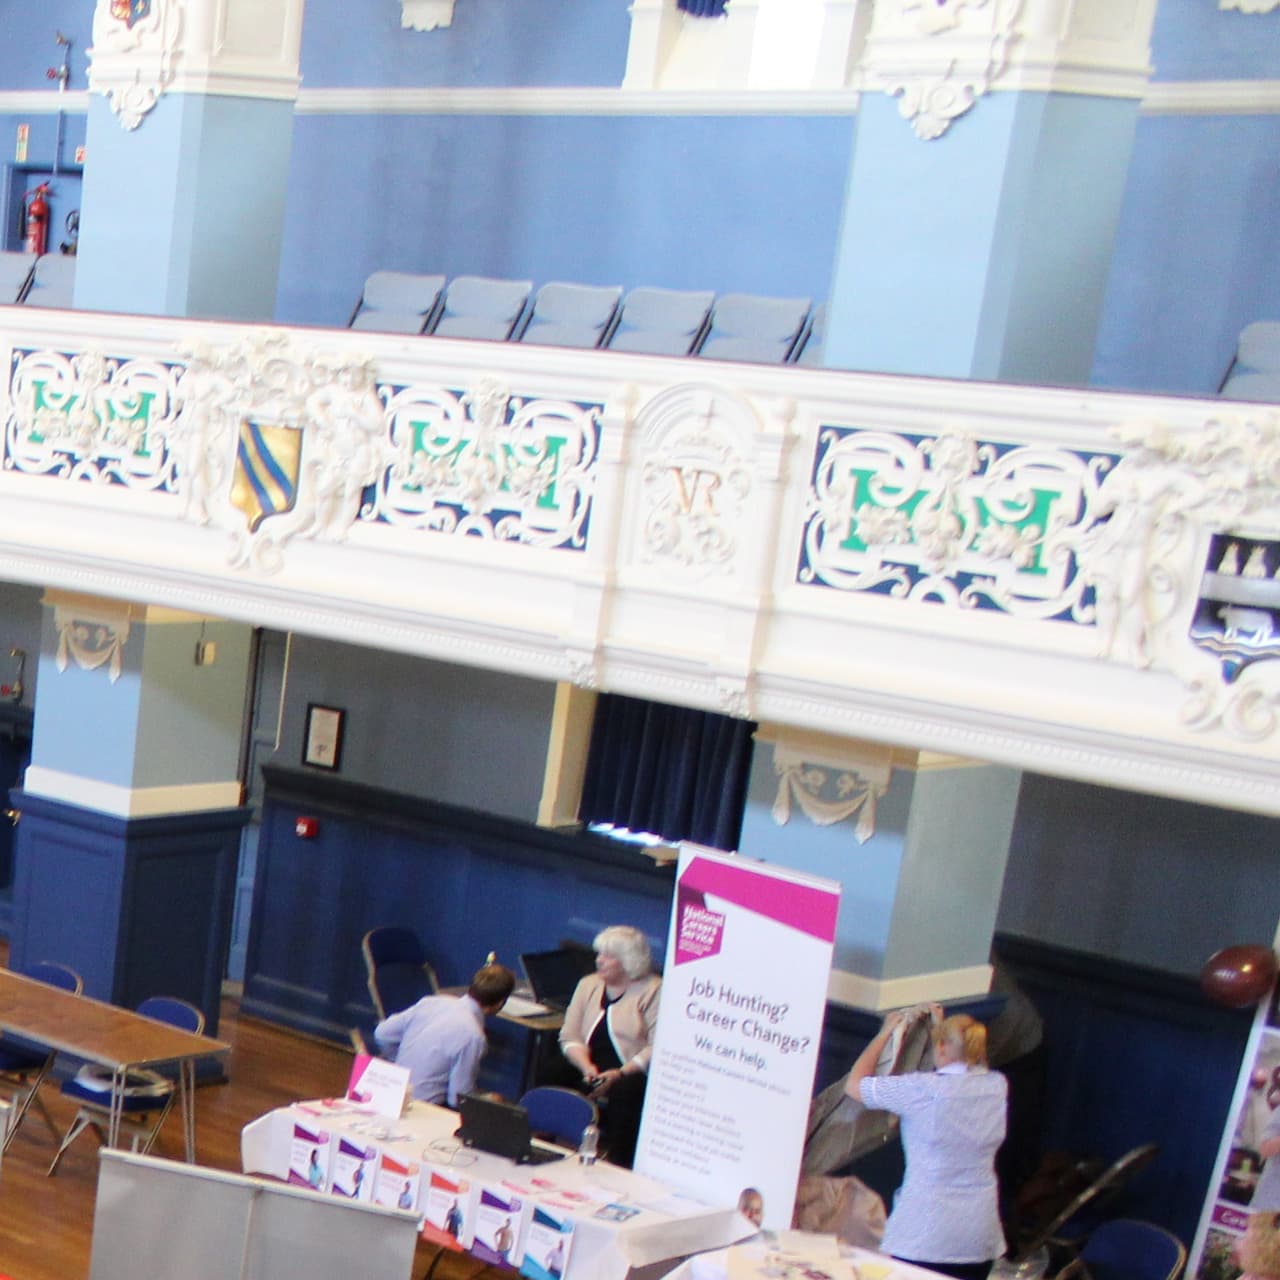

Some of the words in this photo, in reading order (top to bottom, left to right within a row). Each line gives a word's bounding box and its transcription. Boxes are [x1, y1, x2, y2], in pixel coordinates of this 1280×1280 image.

[688, 976, 715, 998] Job
[718, 983, 790, 1024] Hunting?
[685, 1002, 739, 1031] Career
[741, 1018, 811, 1054] Change?
[693, 1033, 713, 1051] We
[714, 1044, 738, 1060] can
[739, 1047, 767, 1072] help.
